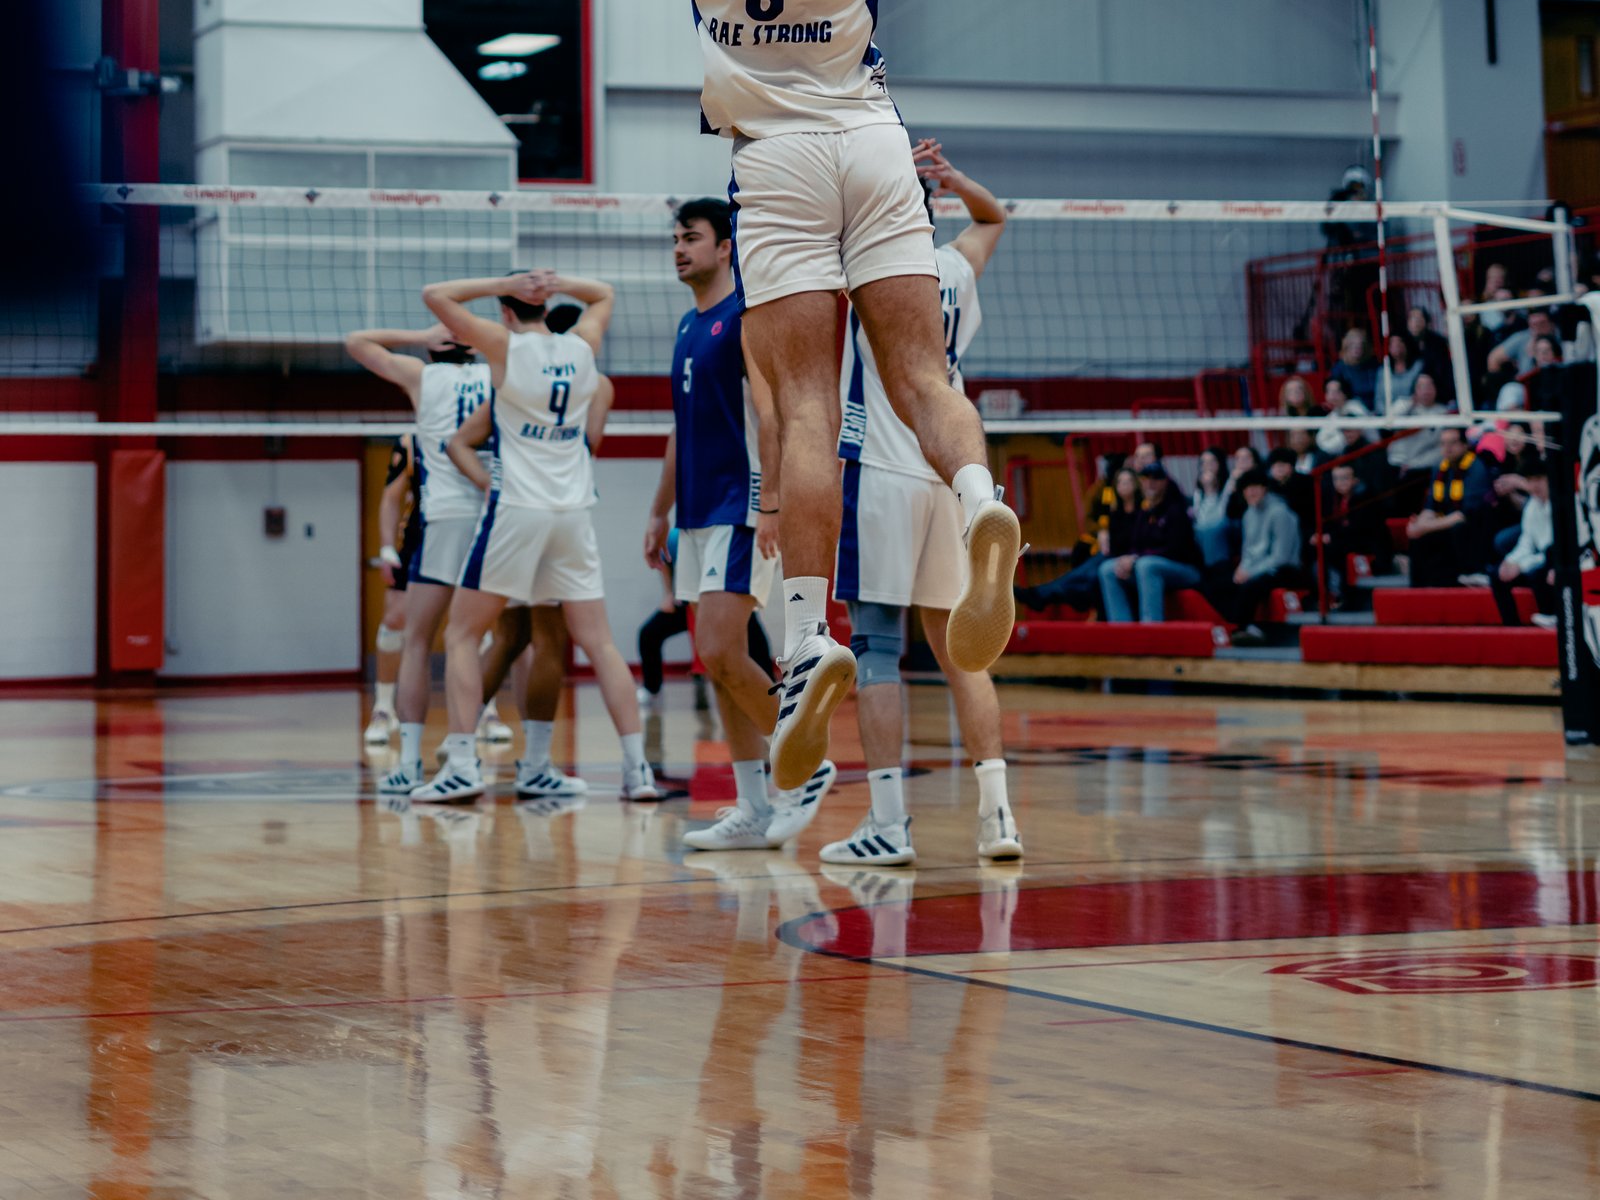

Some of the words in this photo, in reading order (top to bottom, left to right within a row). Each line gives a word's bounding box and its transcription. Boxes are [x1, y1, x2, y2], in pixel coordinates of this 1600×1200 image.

[753, 21, 832, 46] STRONG
[683, 357, 694, 393] 5
[549, 381, 570, 427] 9
